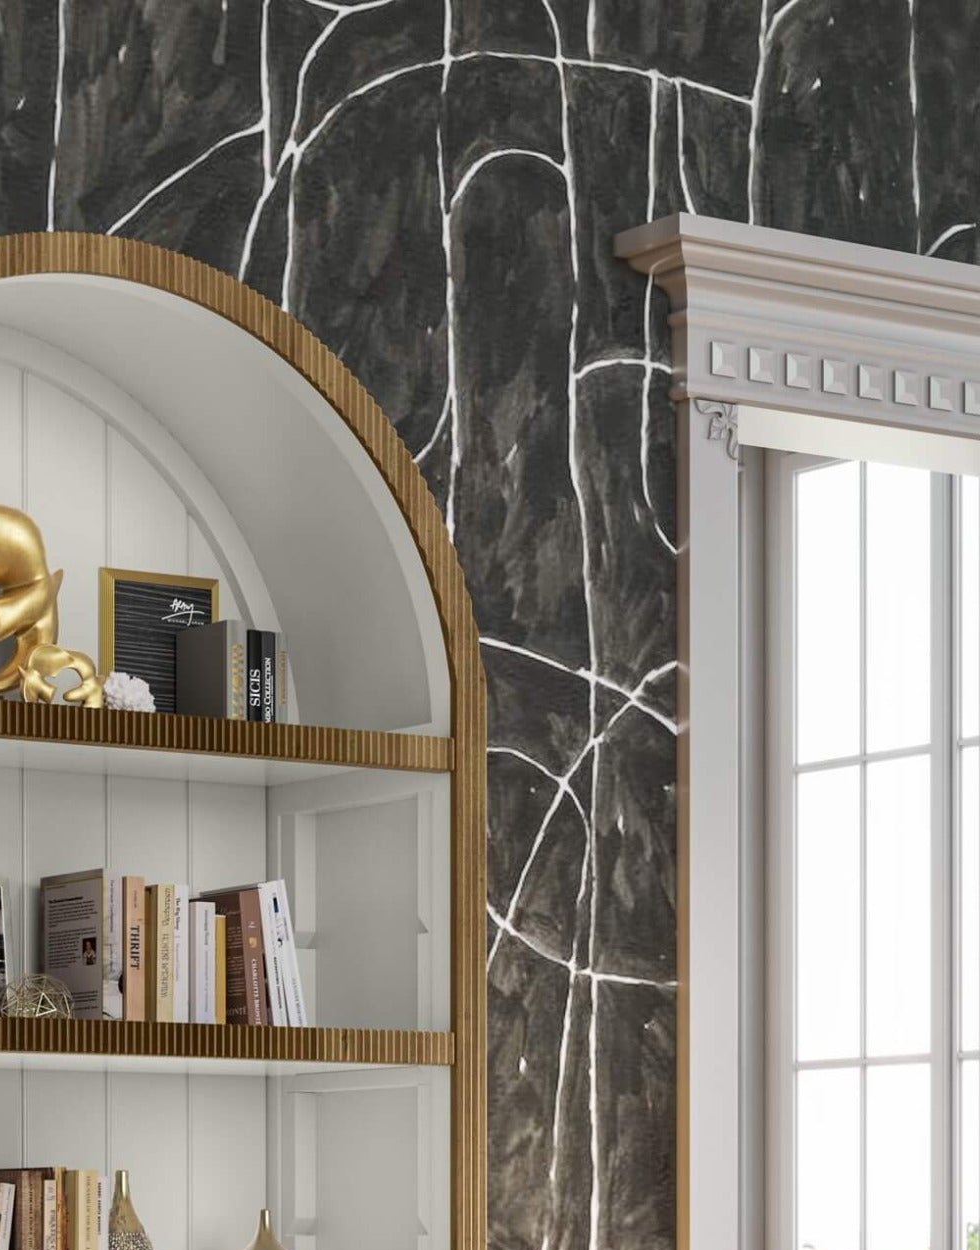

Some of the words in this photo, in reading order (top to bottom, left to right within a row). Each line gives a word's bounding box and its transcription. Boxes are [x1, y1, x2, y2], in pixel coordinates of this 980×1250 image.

[249, 668, 261, 707] SICIS
[263, 657, 271, 705] COLLECTION
[129, 924, 140, 971] THRIFT
[251, 958, 260, 998] CHARLOTTE
